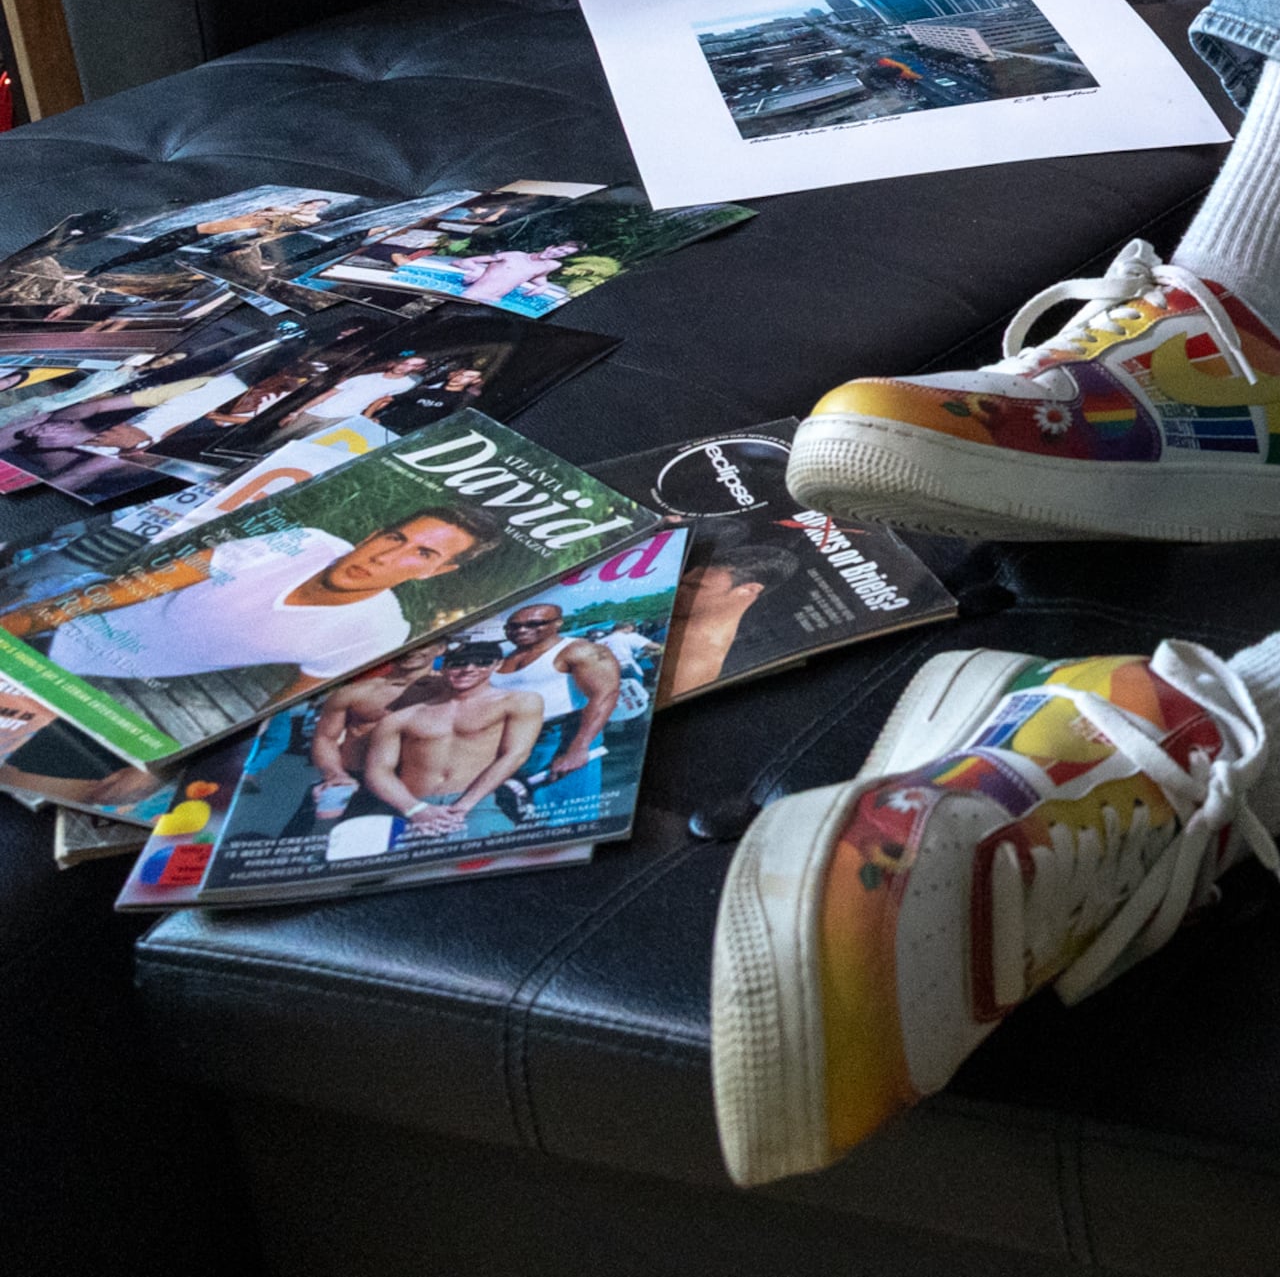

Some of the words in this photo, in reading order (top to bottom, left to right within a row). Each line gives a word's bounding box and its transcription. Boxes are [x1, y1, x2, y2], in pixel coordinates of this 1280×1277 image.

[503, 454, 563, 492] ATLANTA
[705, 443, 755, 507] eclipse
[133, 521, 163, 537] TO
[504, 525, 553, 559] MAGAZINE
[827, 549, 865, 568] or
[839, 561, 910, 611] Briefs?
[307, 863, 326, 873] OF
[329, 853, 410, 871] THOUSANDS
[412, 847, 459, 859] MARCH
[461, 841, 481, 852] ON
